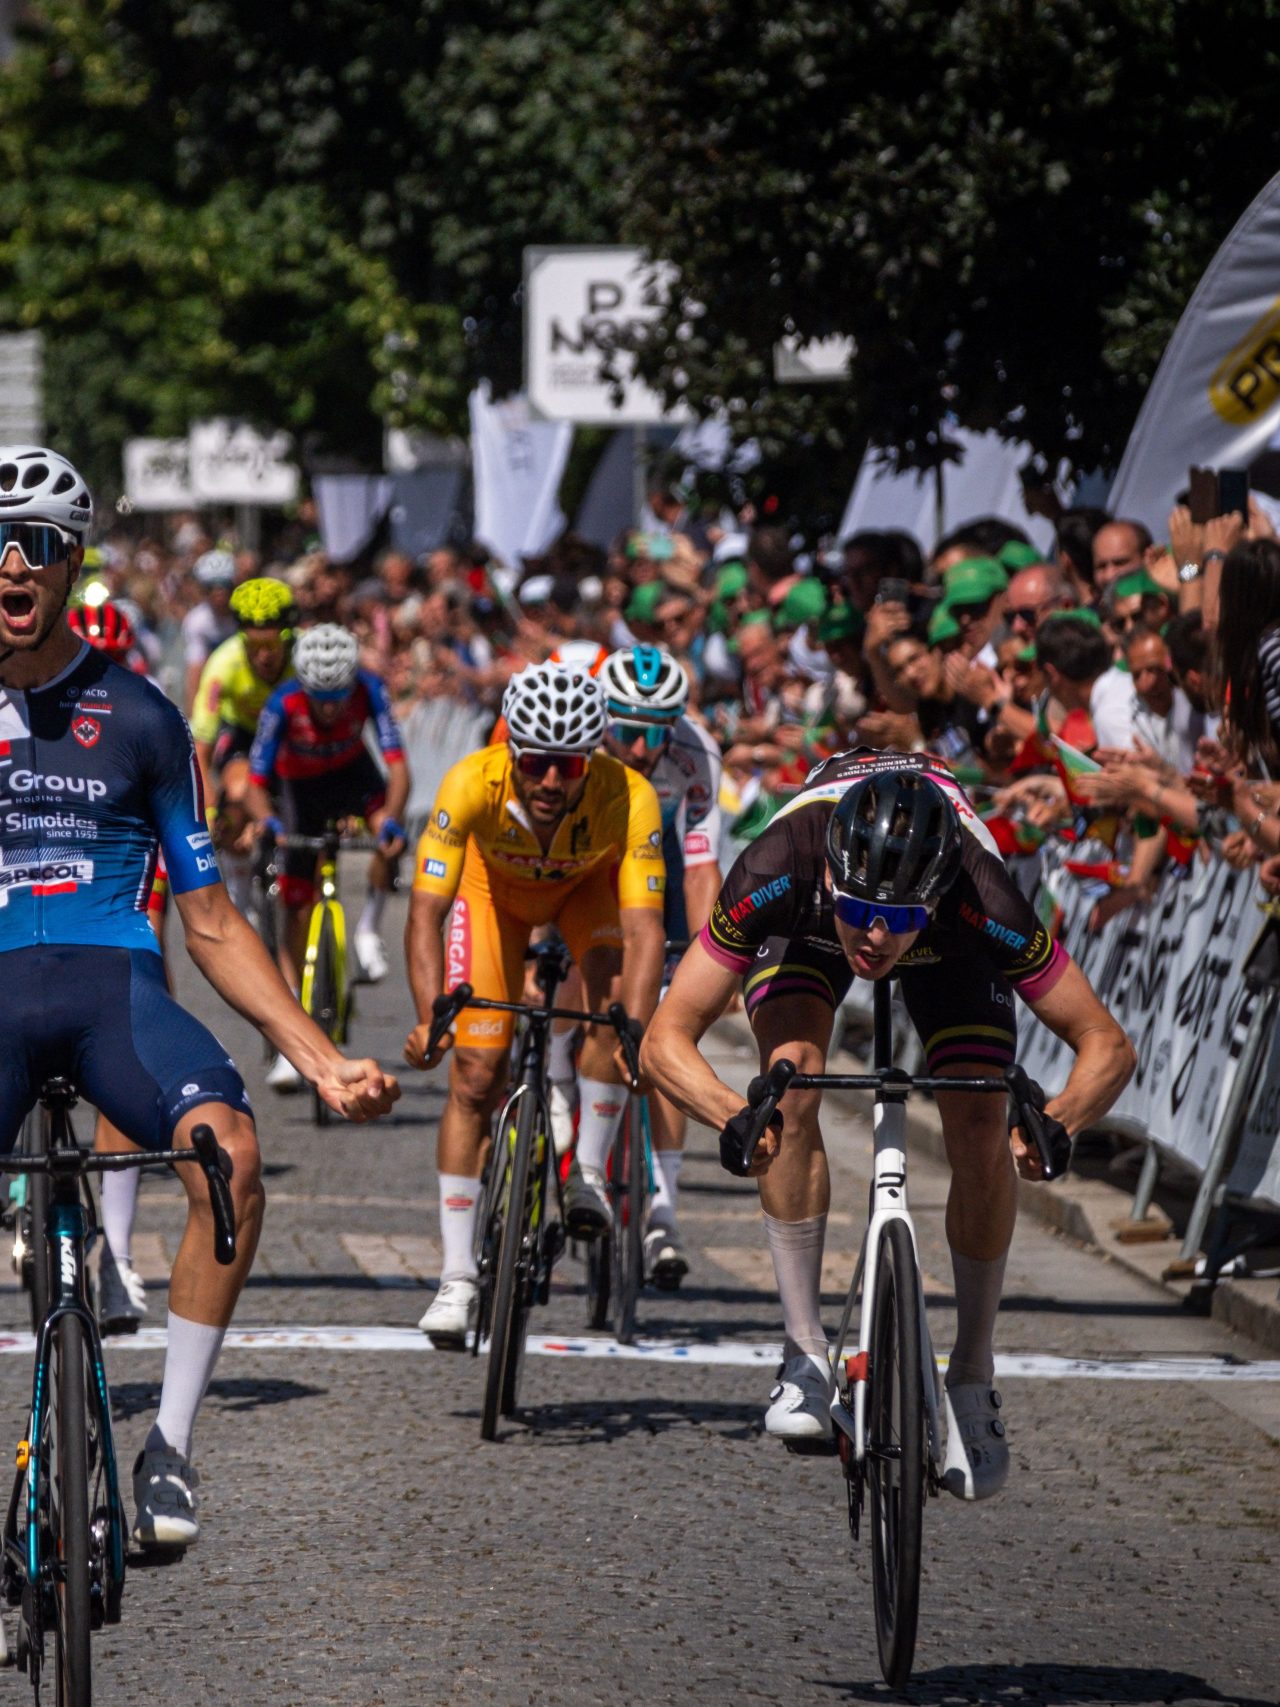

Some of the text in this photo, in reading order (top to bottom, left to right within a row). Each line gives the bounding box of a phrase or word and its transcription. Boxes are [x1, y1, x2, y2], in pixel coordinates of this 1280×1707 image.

[8, 769, 108, 802] Group
[5, 812, 98, 833] Simoldes
[46, 829, 98, 839] since 1959
[728, 873, 792, 924] MATDIVER
[959, 902, 1027, 950] MATDIVER
[60, 1235, 77, 1286] KTM
